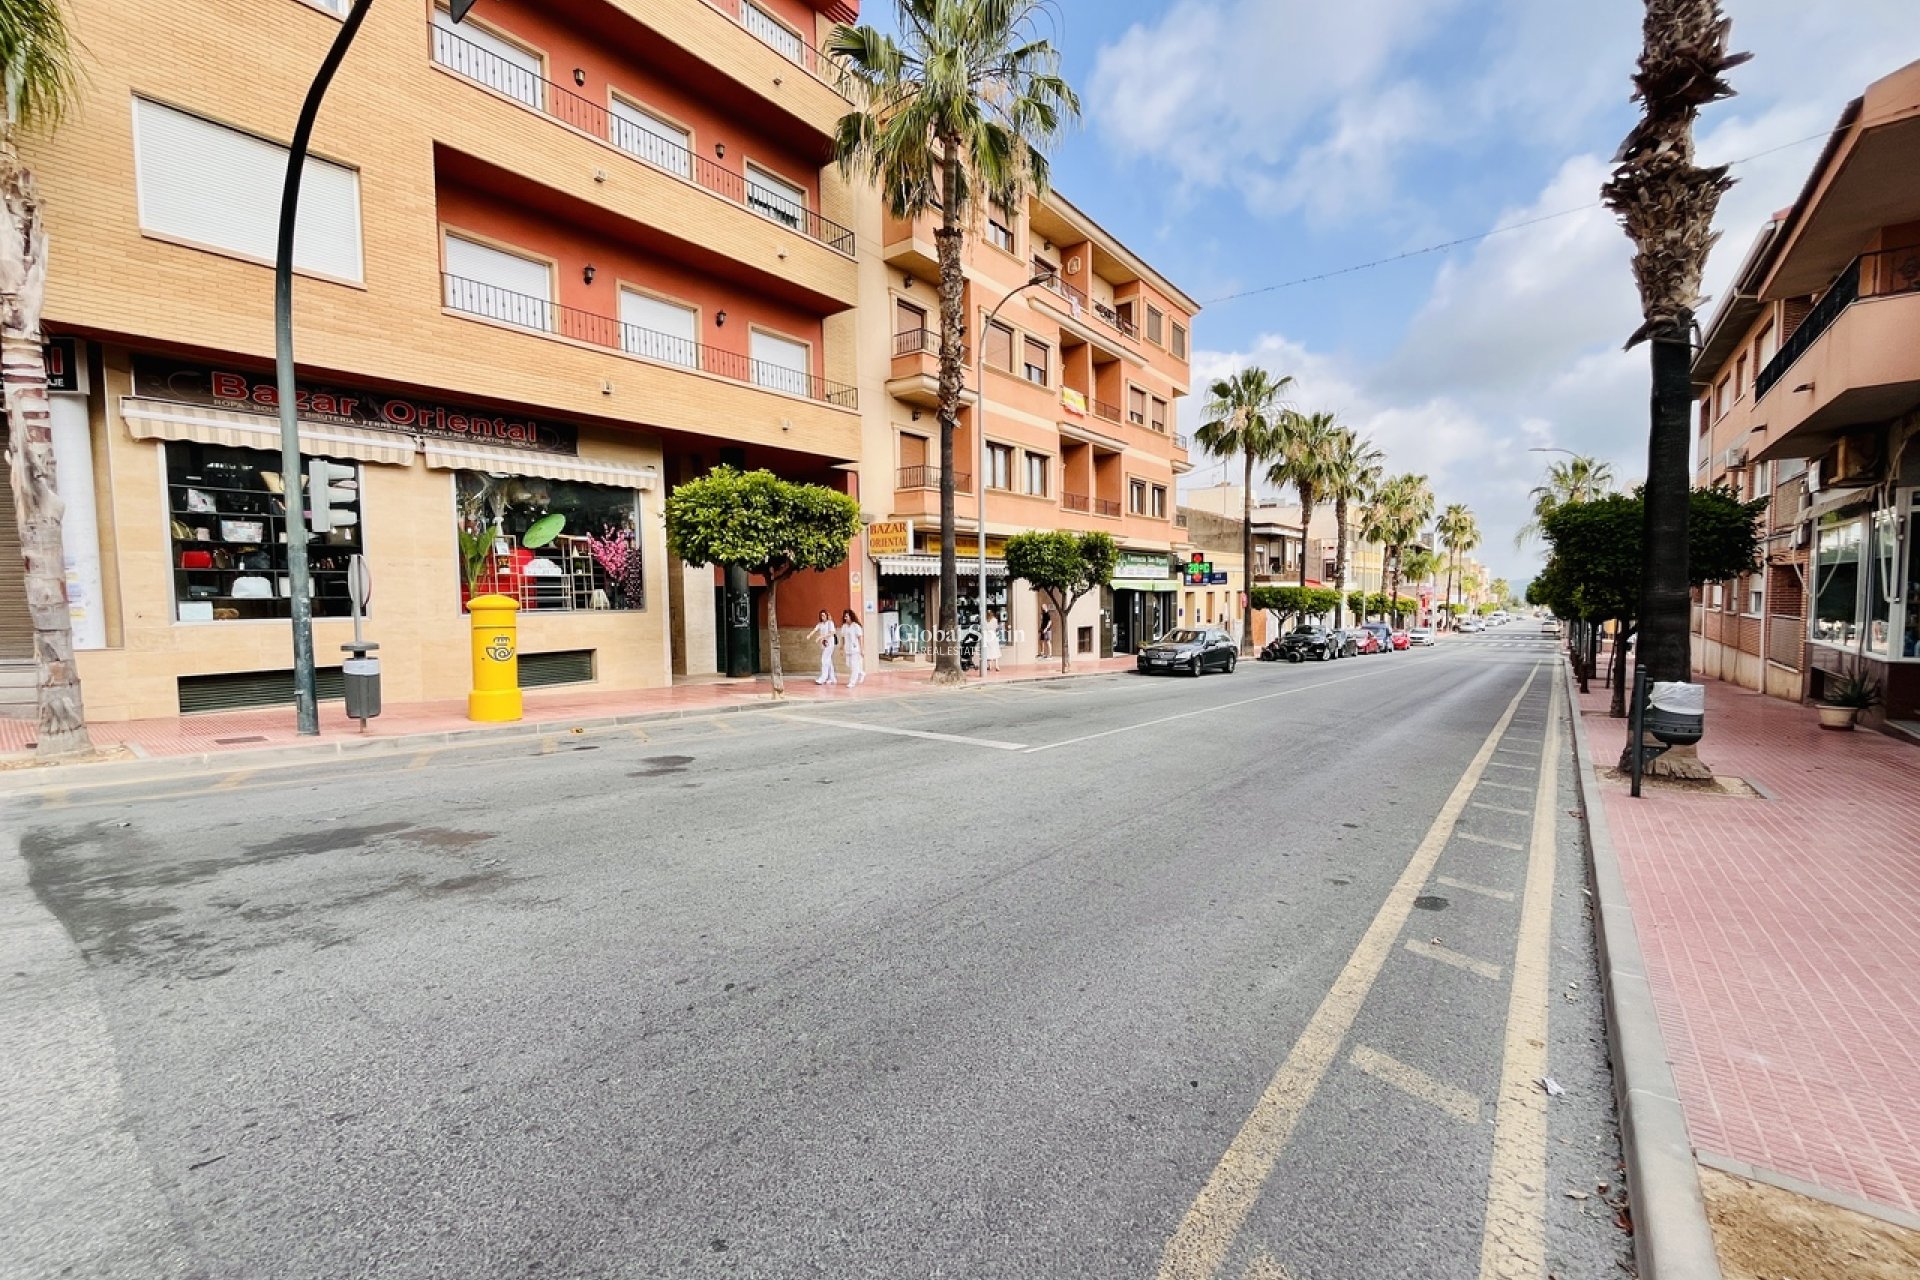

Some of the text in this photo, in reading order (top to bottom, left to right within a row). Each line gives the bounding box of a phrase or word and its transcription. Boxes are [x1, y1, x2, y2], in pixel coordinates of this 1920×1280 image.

[212, 371, 538, 443] Bazar Oriental
[214, 399, 244, 409] ROPA
[869, 522, 907, 535] BAZAR
[869, 536, 908, 548] ORIENTAL
